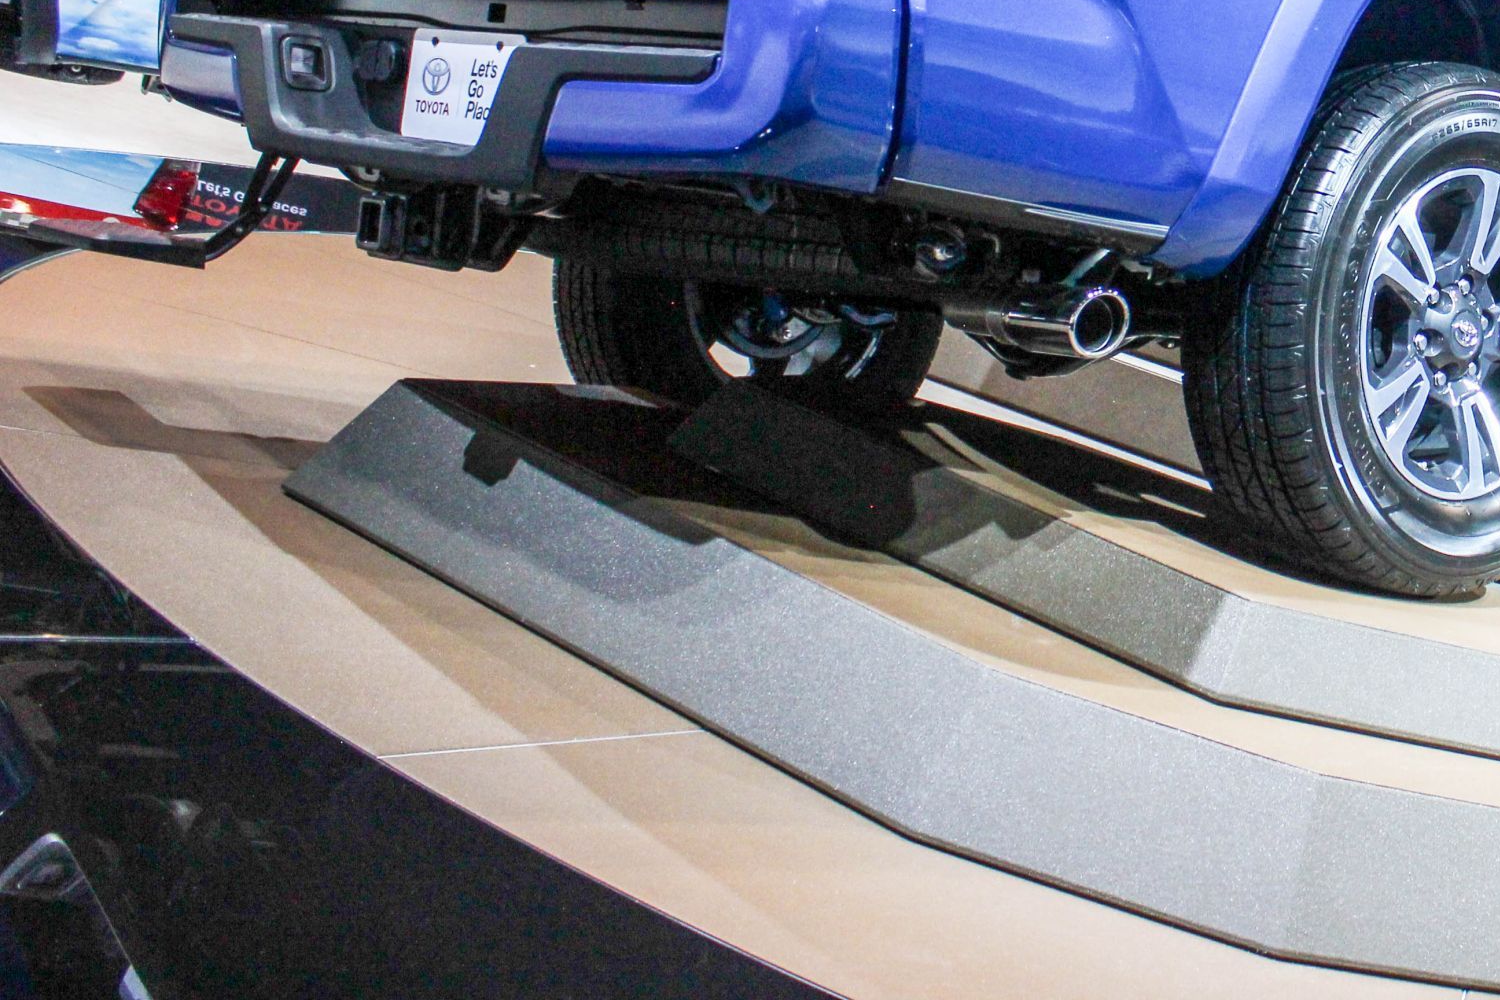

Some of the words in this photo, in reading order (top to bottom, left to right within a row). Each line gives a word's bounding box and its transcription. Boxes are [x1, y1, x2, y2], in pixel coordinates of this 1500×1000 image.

[471, 58, 498, 79] Let's
[468, 79, 484, 99] Go
[416, 99, 450, 117] TOYOTA
[465, 101, 490, 120] Plac
